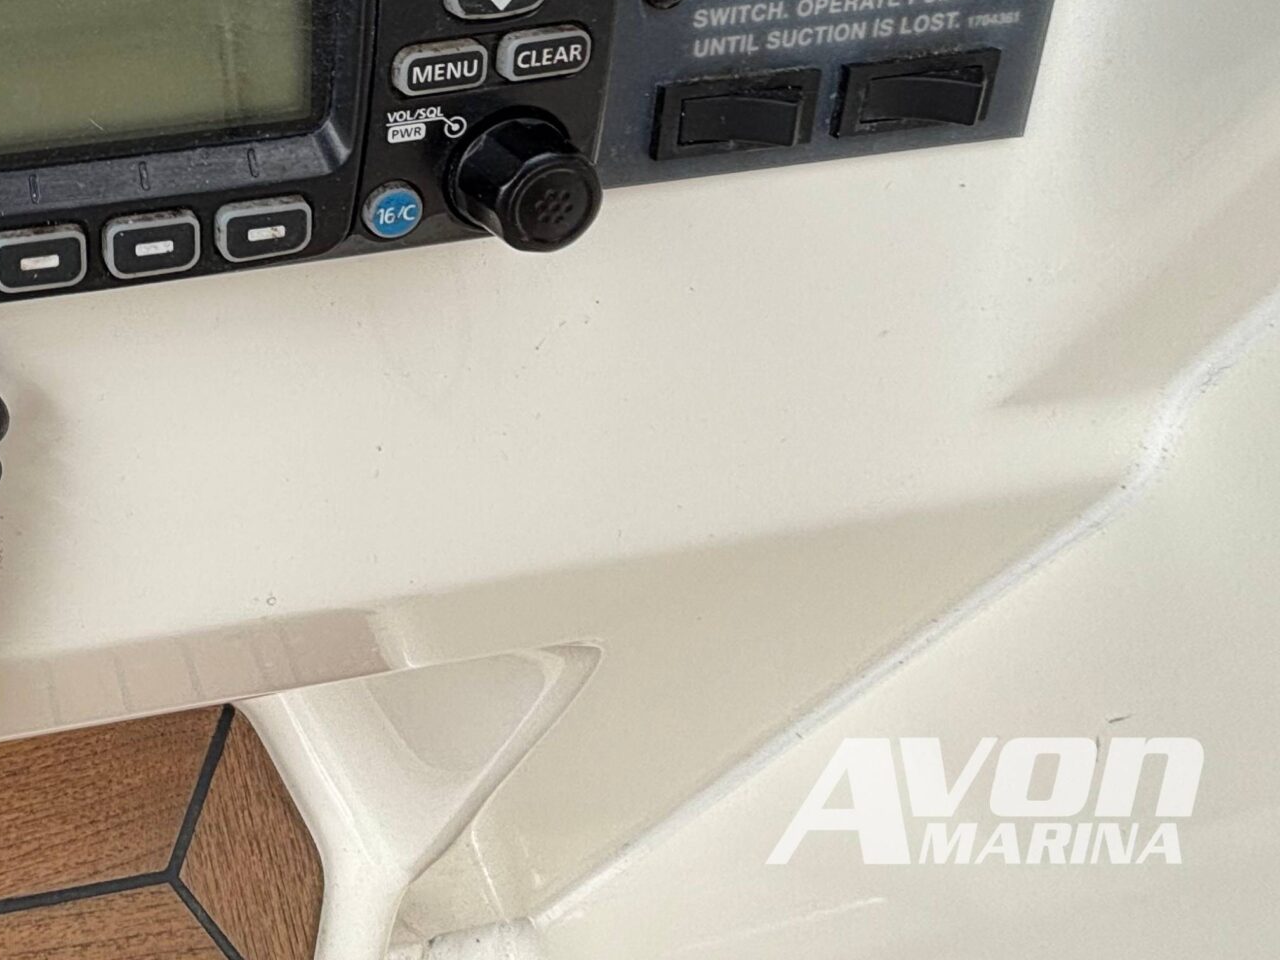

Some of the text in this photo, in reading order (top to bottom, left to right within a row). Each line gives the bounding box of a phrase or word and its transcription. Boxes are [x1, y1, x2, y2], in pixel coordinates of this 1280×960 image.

[693, 3, 790, 28] SWITCH.
[694, 34, 762, 58] UNTIL
[766, 22, 867, 50] SUCTION
[871, 18, 894, 38] IS
[899, 12, 961, 34] LOST.
[517, 43, 582, 69] CLEAR
[412, 59, 479, 84] MENU
[387, 105, 444, 122] VOL/SQL
[391, 125, 423, 139] PWR
[376, 204, 416, 225] 16/C
